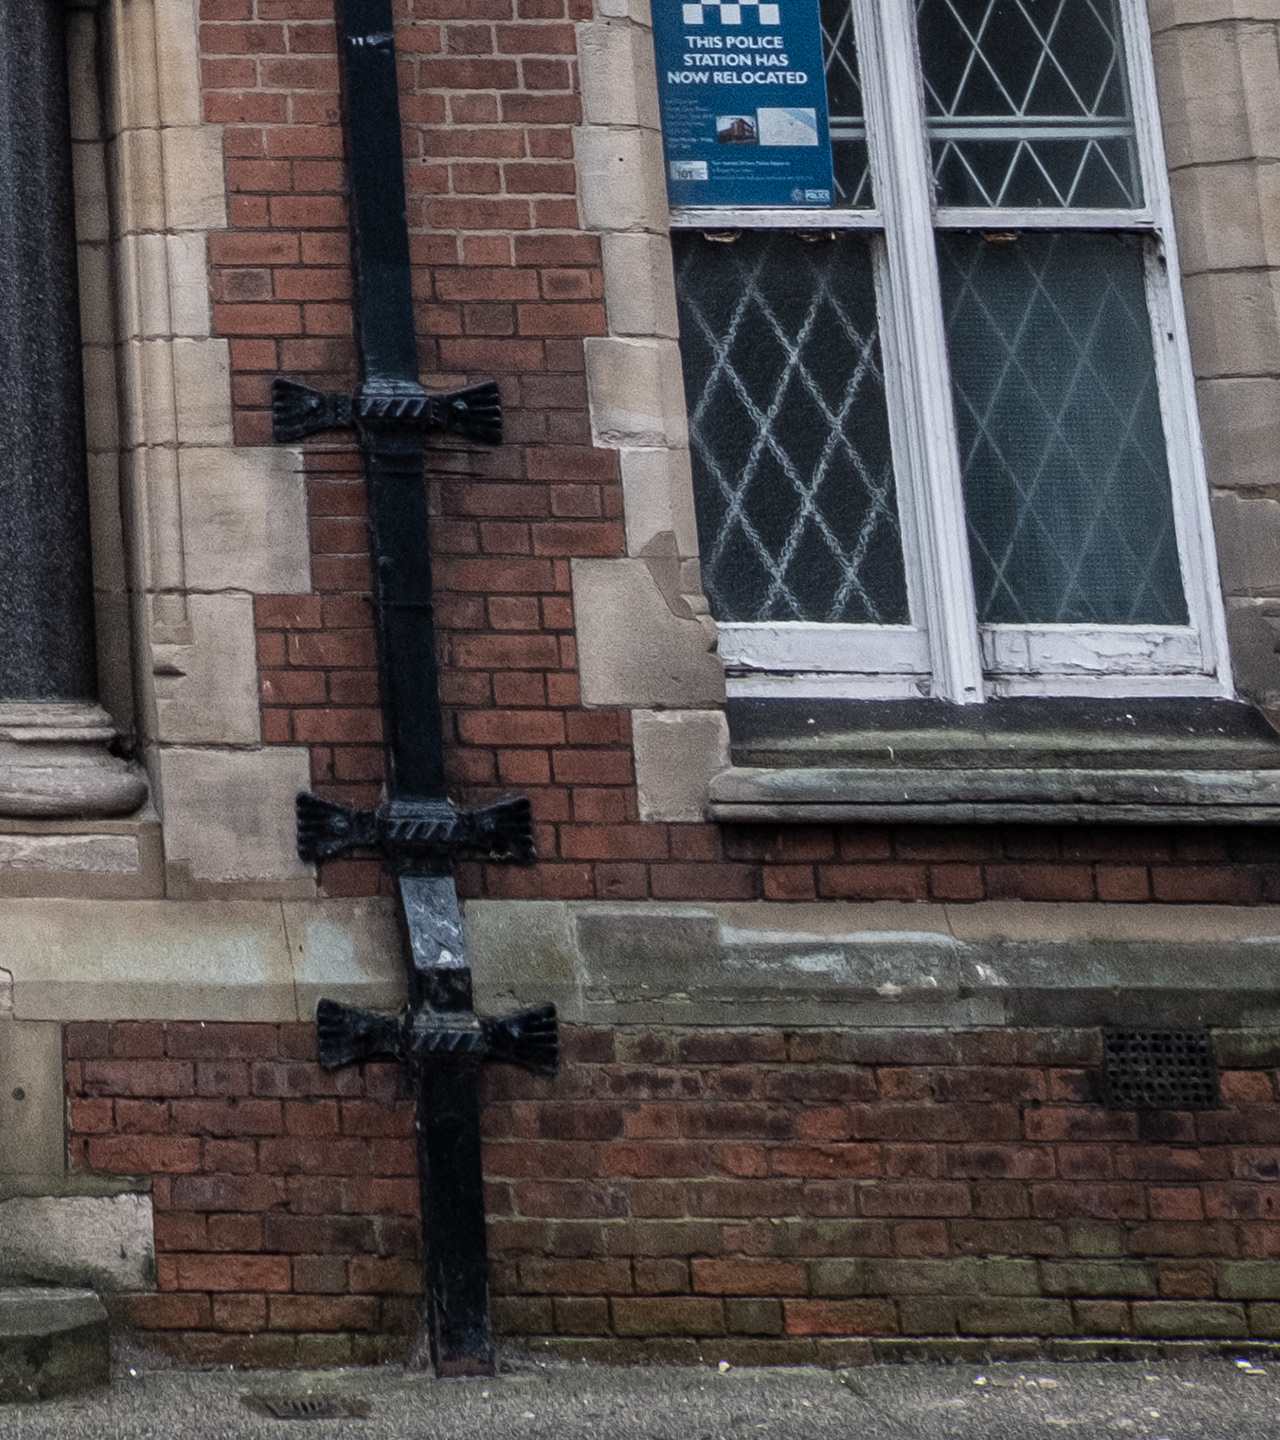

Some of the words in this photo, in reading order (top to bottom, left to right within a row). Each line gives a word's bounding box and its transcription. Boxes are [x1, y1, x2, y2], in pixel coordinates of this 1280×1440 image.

[684, 36, 722, 49] THIS
[726, 36, 784, 49] POLICE
[683, 53, 752, 67] STATION
[755, 53, 789, 67] HAS
[667, 71, 710, 84] NOW
[713, 71, 808, 84] RELOCATED
